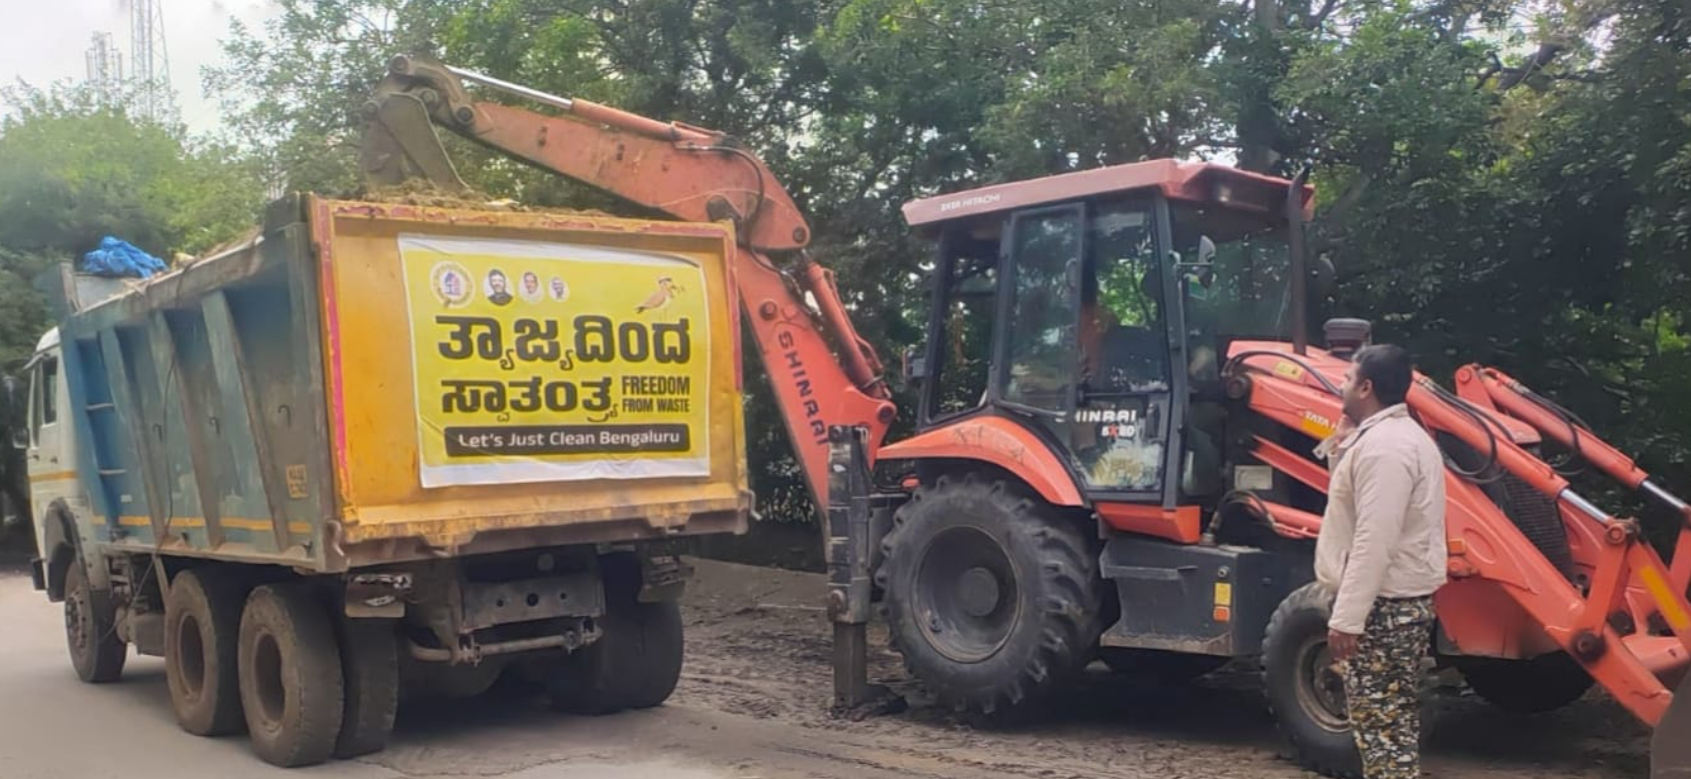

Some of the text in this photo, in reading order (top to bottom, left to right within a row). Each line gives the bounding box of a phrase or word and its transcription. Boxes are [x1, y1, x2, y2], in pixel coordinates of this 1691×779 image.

[435, 314, 691, 371] ತ್ಯಾಜ್ಯದಿಂದ
[621, 375, 690, 396] FREEDOM
[777, 330, 829, 446] SHINRAI
[440, 376, 618, 422] ಸ್ವಾತಂತ್ರ್ಯ
[622, 398, 690, 413] FROM WASTE
[1303, 410, 1329, 428] TATA
[458, 429, 680, 448] Let's Just Clean Bengaluru
